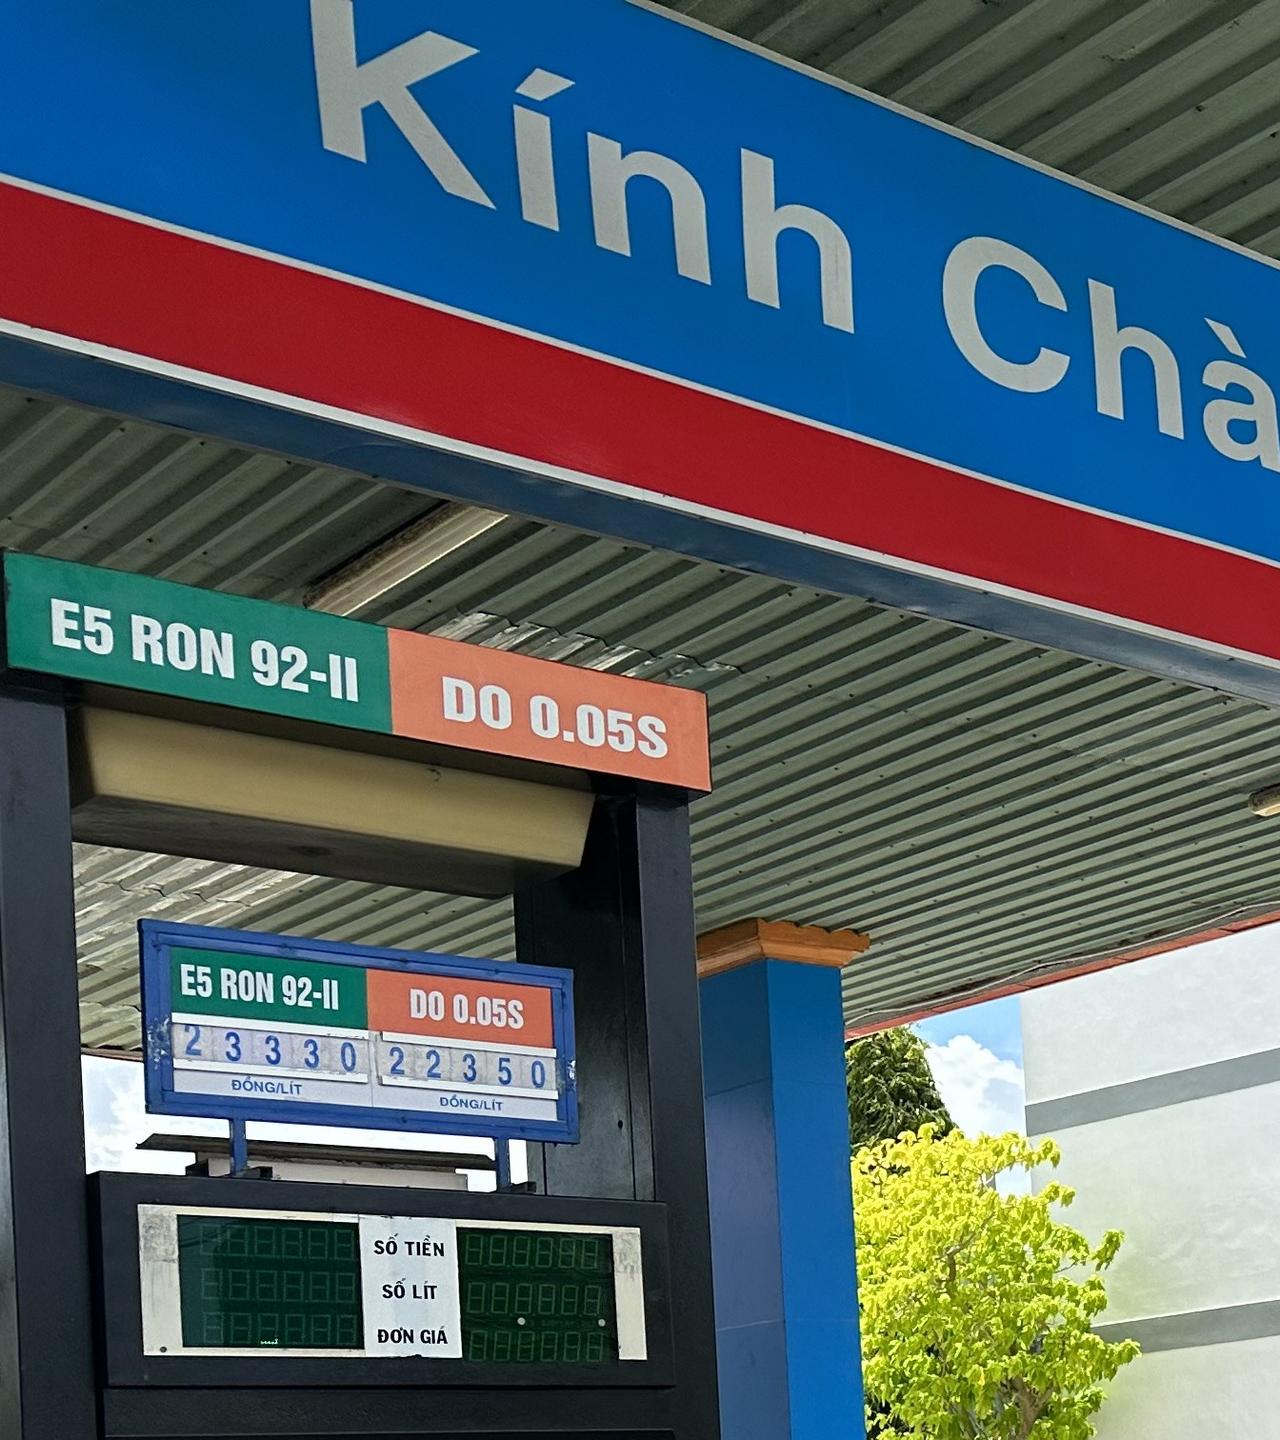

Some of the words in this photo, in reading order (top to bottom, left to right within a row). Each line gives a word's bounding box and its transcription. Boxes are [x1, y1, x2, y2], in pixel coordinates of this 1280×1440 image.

[310, 0, 856, 335] Kính
[50, 598, 114, 655] E5
[131, 615, 236, 679] RON
[251, 640, 359, 703] 92-II
[443, 676, 512, 730] DO
[529, 694, 669, 758] 0.05S
[180, 964, 213, 998] E5
[220, 968, 275, 1006] RON
[282, 976, 339, 1011] 92-II
[410, 988, 444, 1021] DO
[452, 994, 524, 1030] 0.05S
[374, 1233, 399, 1256] SỐ
[404, 1234, 445, 1257] TIỀN
[382, 1278, 406, 1299] SỐ
[412, 1281, 437, 1300] LÍT
[377, 1326, 414, 1345] ĐƠN
[420, 1326, 448, 1345] GIÁ
